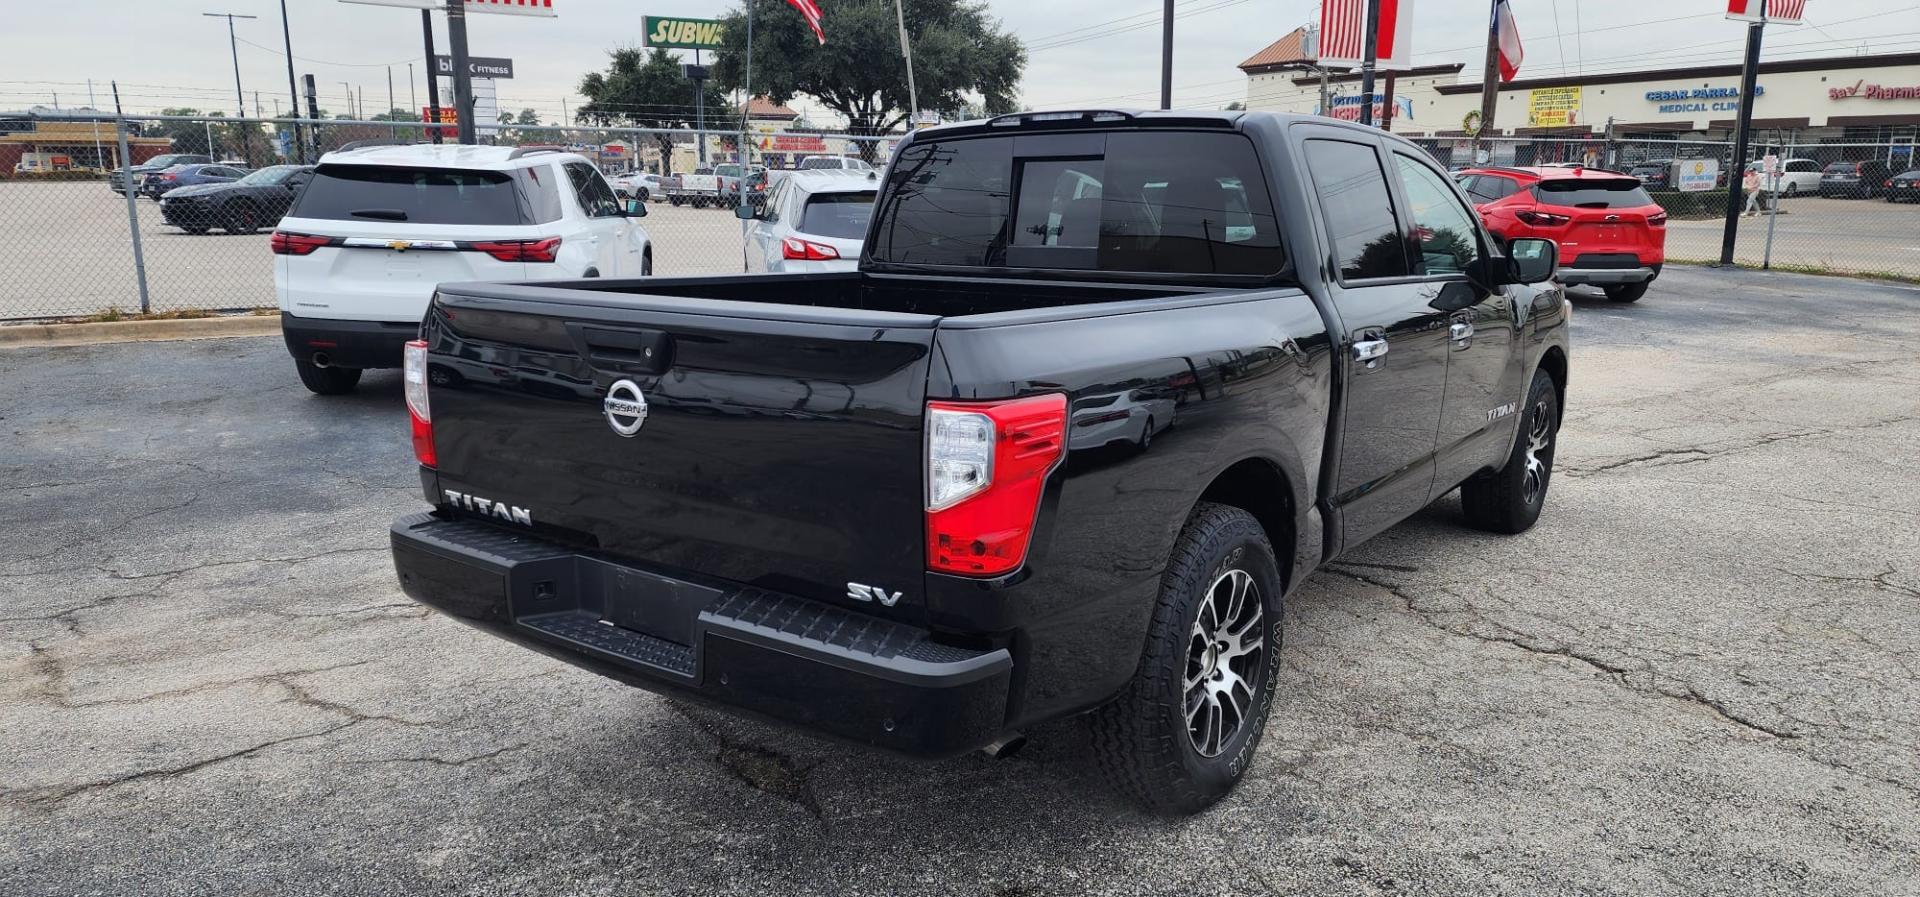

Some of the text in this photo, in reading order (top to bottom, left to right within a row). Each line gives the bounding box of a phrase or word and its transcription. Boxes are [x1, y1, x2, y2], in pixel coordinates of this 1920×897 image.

[650, 20, 724, 45] SUBWA
[440, 59, 509, 74] blk FITNESS
[1645, 90, 1688, 101] CESAR
[1692, 87, 1739, 99] PARRA
[1659, 102, 1739, 113] MEDICAL CLIN
[607, 401, 641, 414] NISSAN
[1487, 402, 1516, 421] TITAN
[444, 489, 532, 527] TITAN
[847, 582, 903, 607] SV
[1228, 619, 1282, 778] WRANGLER
